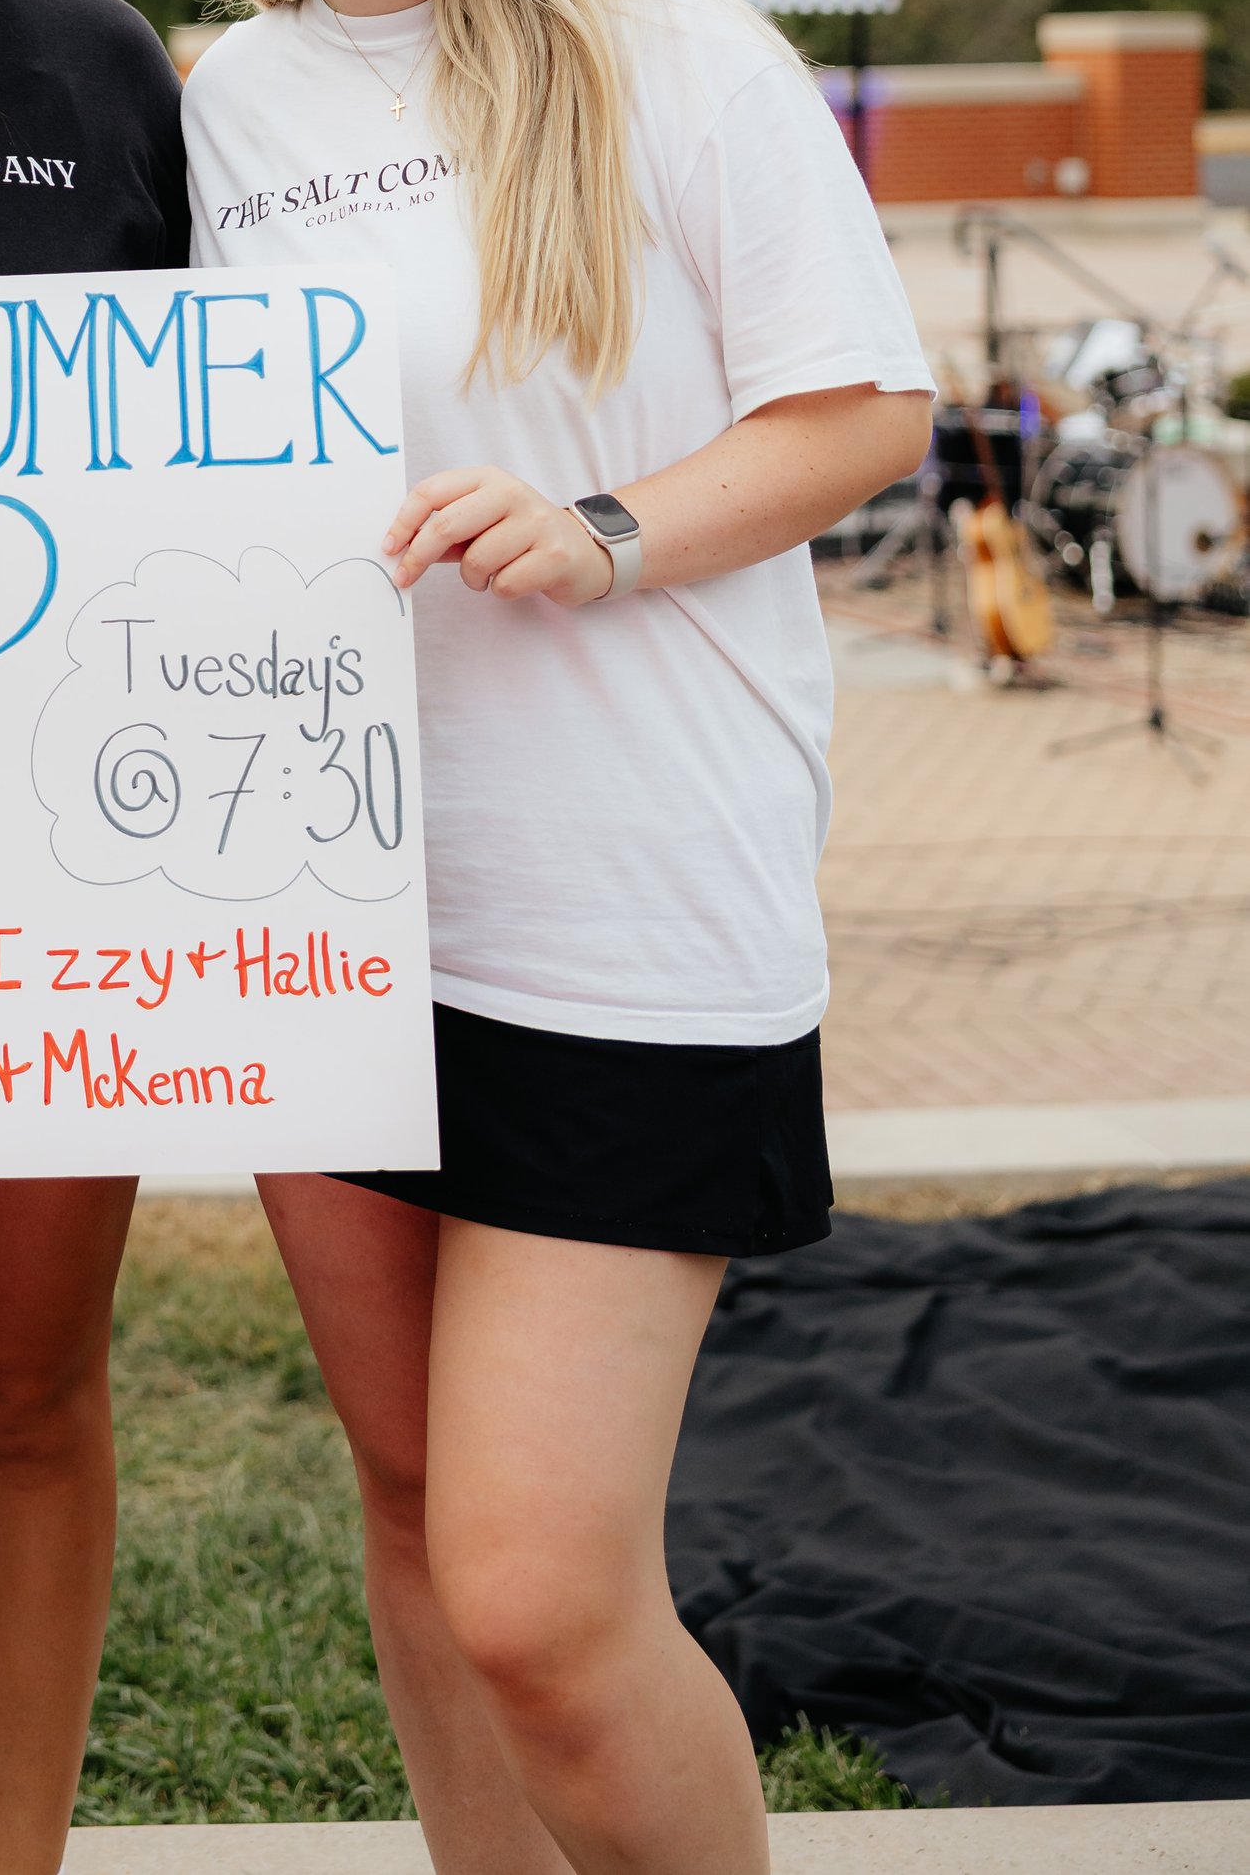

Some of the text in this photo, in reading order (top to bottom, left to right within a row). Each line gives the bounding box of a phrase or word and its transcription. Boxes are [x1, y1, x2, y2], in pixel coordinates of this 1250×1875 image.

[216, 192, 275, 231] THE
[281, 172, 368, 213] SALT
[305, 191, 435, 228] COLUMBIA, MO
[100, 619, 364, 743] Tuesday's
[94, 722, 403, 855] @ 7:30
[233, 927, 393, 998] Hallie
